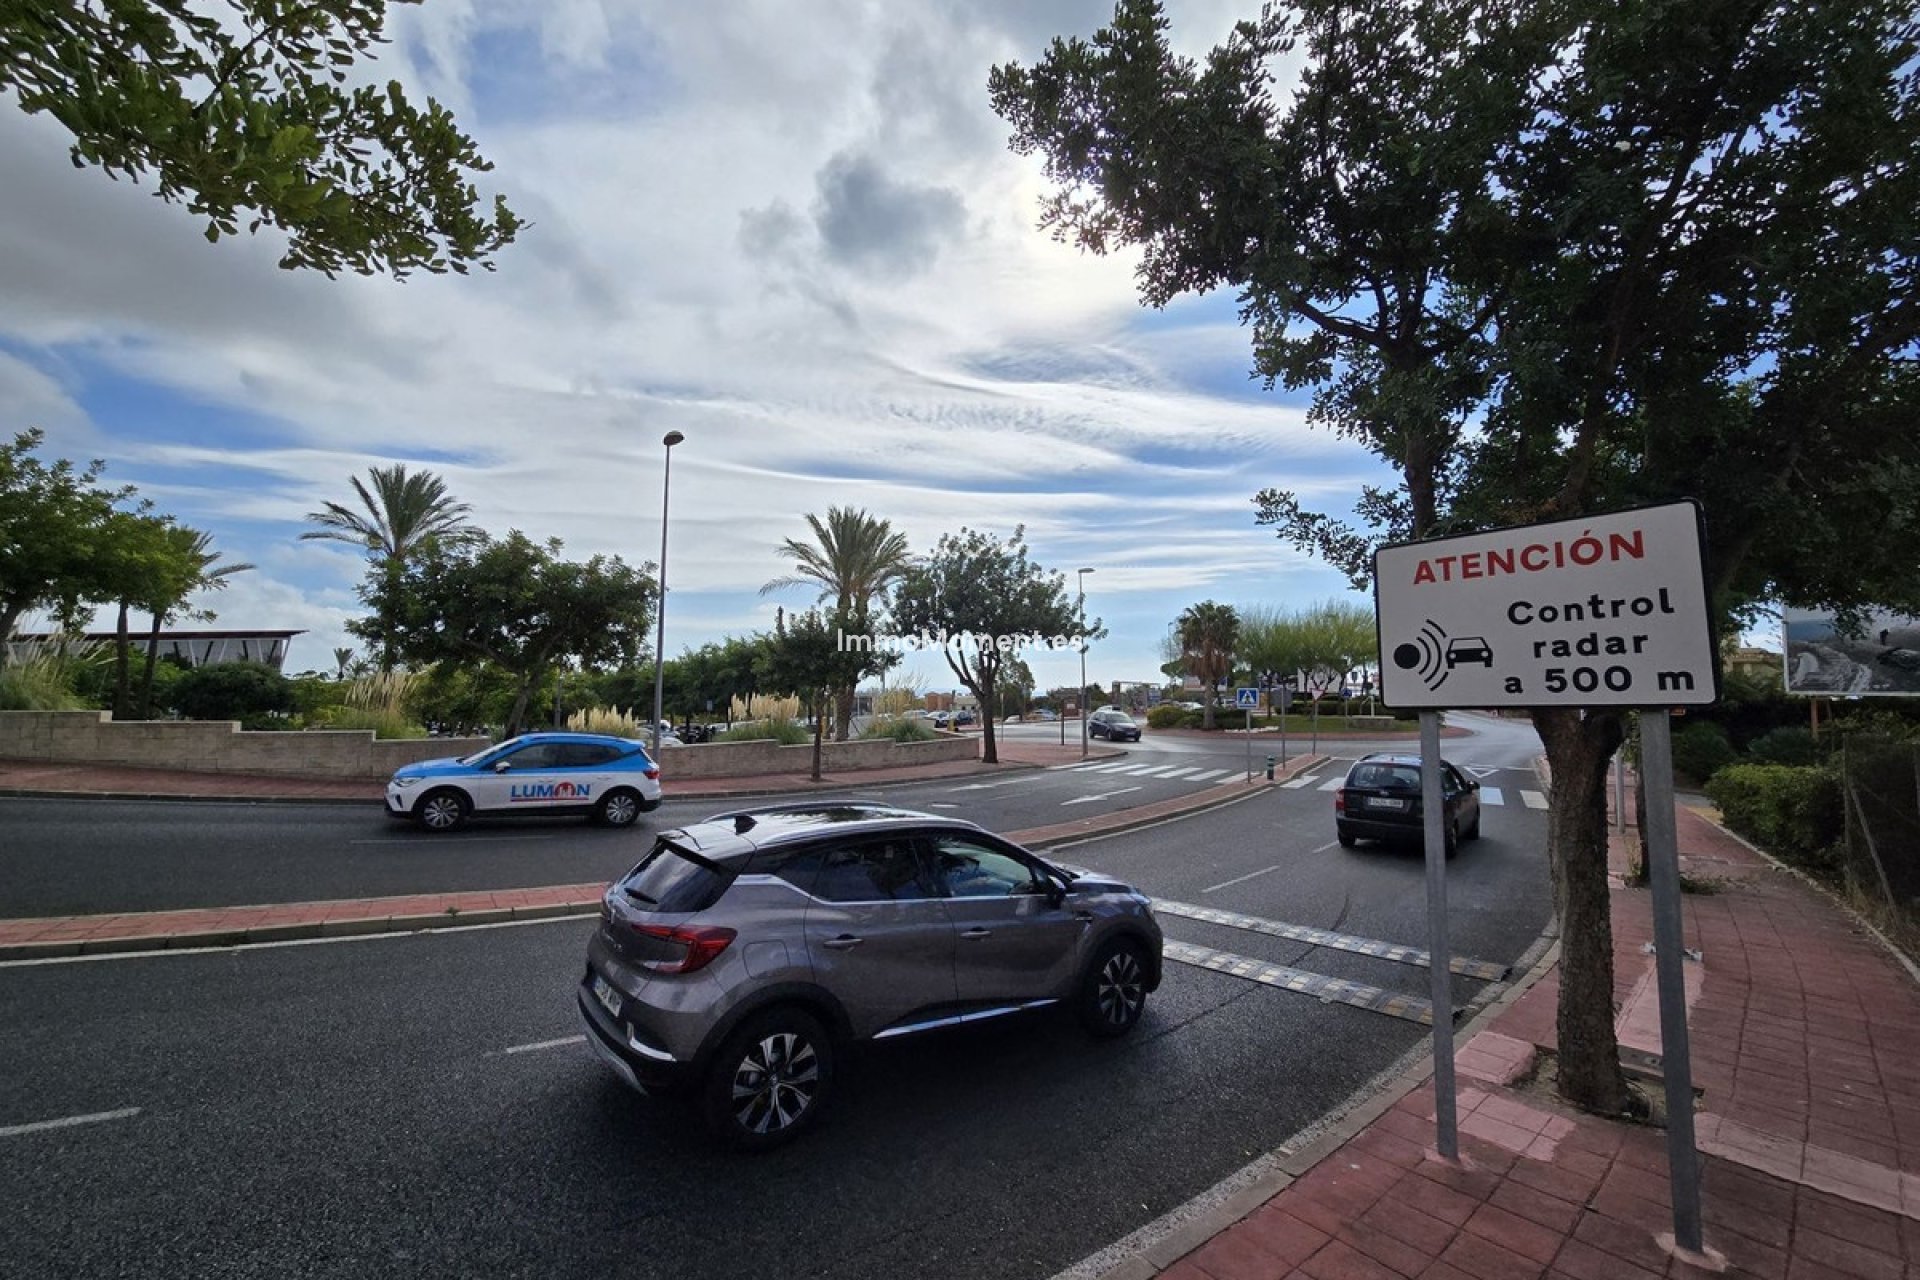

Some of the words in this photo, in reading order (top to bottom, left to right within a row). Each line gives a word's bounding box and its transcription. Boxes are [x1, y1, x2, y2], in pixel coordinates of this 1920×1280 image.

[1413, 529, 1646, 586] ATENCIÓN
[1507, 587, 1675, 626] Control
[1533, 632, 1649, 659] radar
[1504, 676, 1524, 694] a
[1545, 665, 1633, 693] 500
[1657, 669, 1696, 692] m
